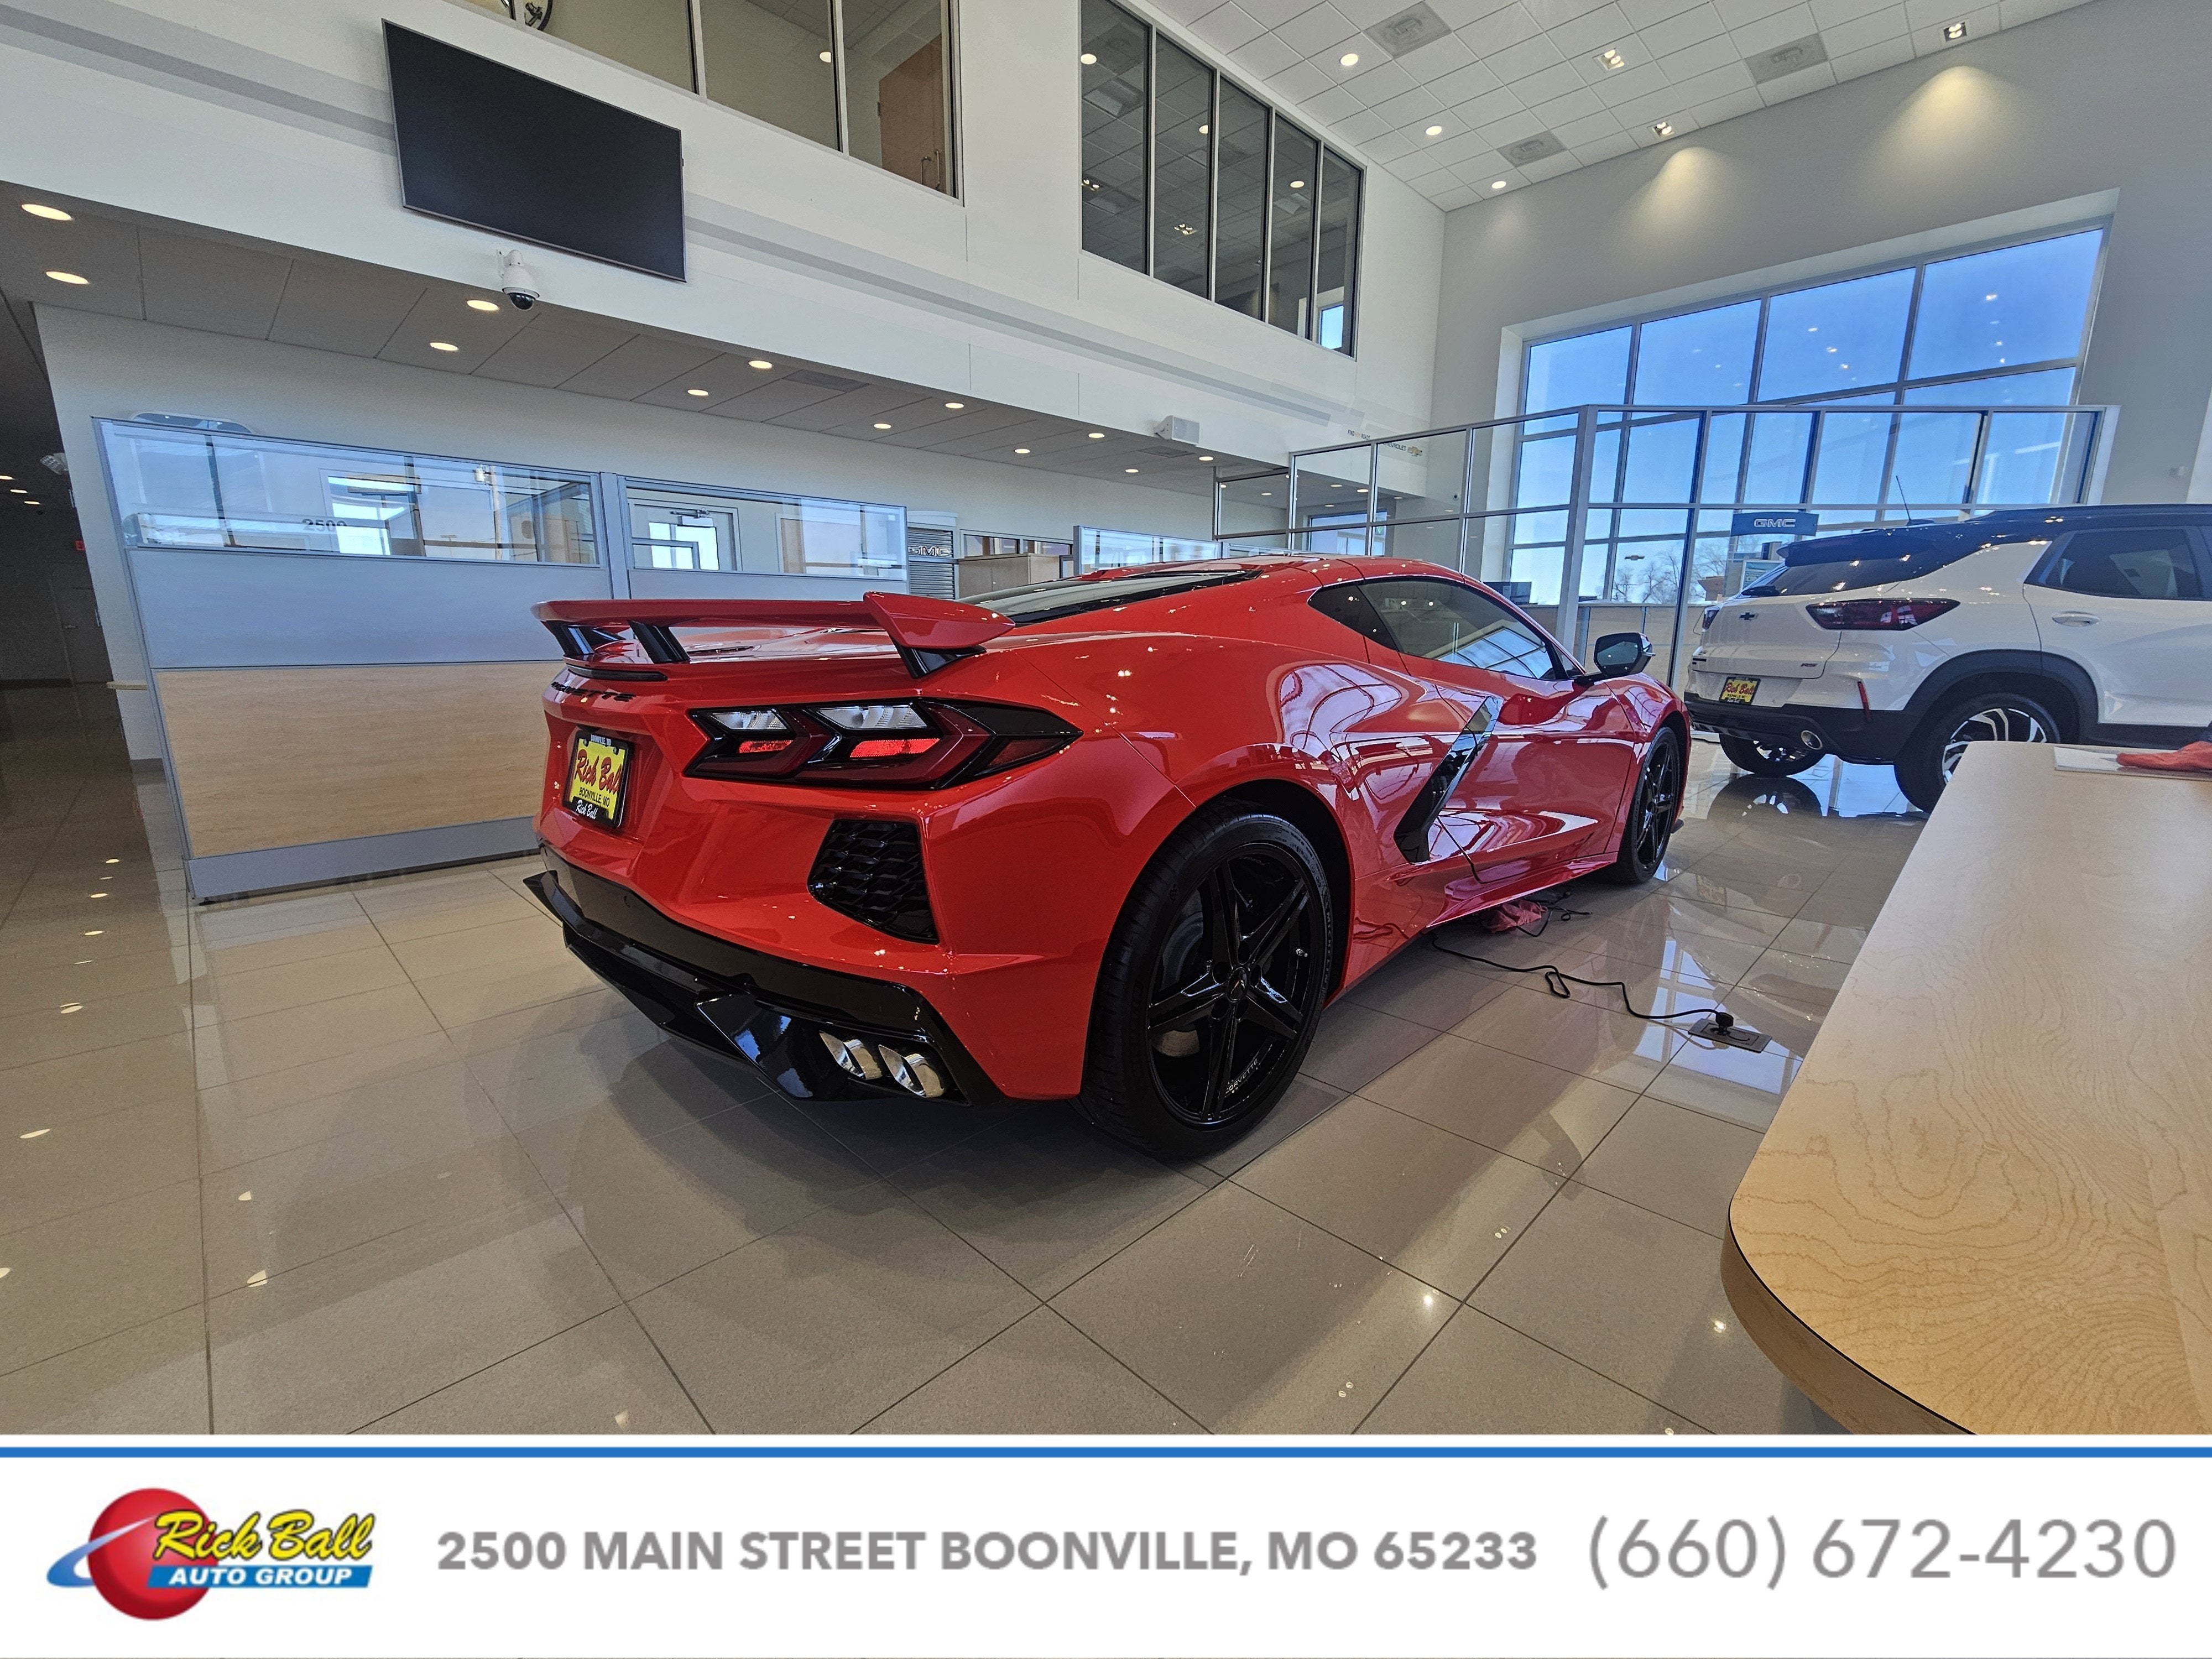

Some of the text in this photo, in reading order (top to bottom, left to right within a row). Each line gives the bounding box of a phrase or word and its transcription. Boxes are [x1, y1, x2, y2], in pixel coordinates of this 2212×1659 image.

[1383, 442, 1406, 451] EVROLET
[1754, 518, 1796, 528] GMC
[907, 545, 952, 557] GMC
[574, 749, 622, 795] Rick Ball
[579, 786, 611, 807] BOONVILLE, MO
[576, 799, 598, 820] Rick Ball
